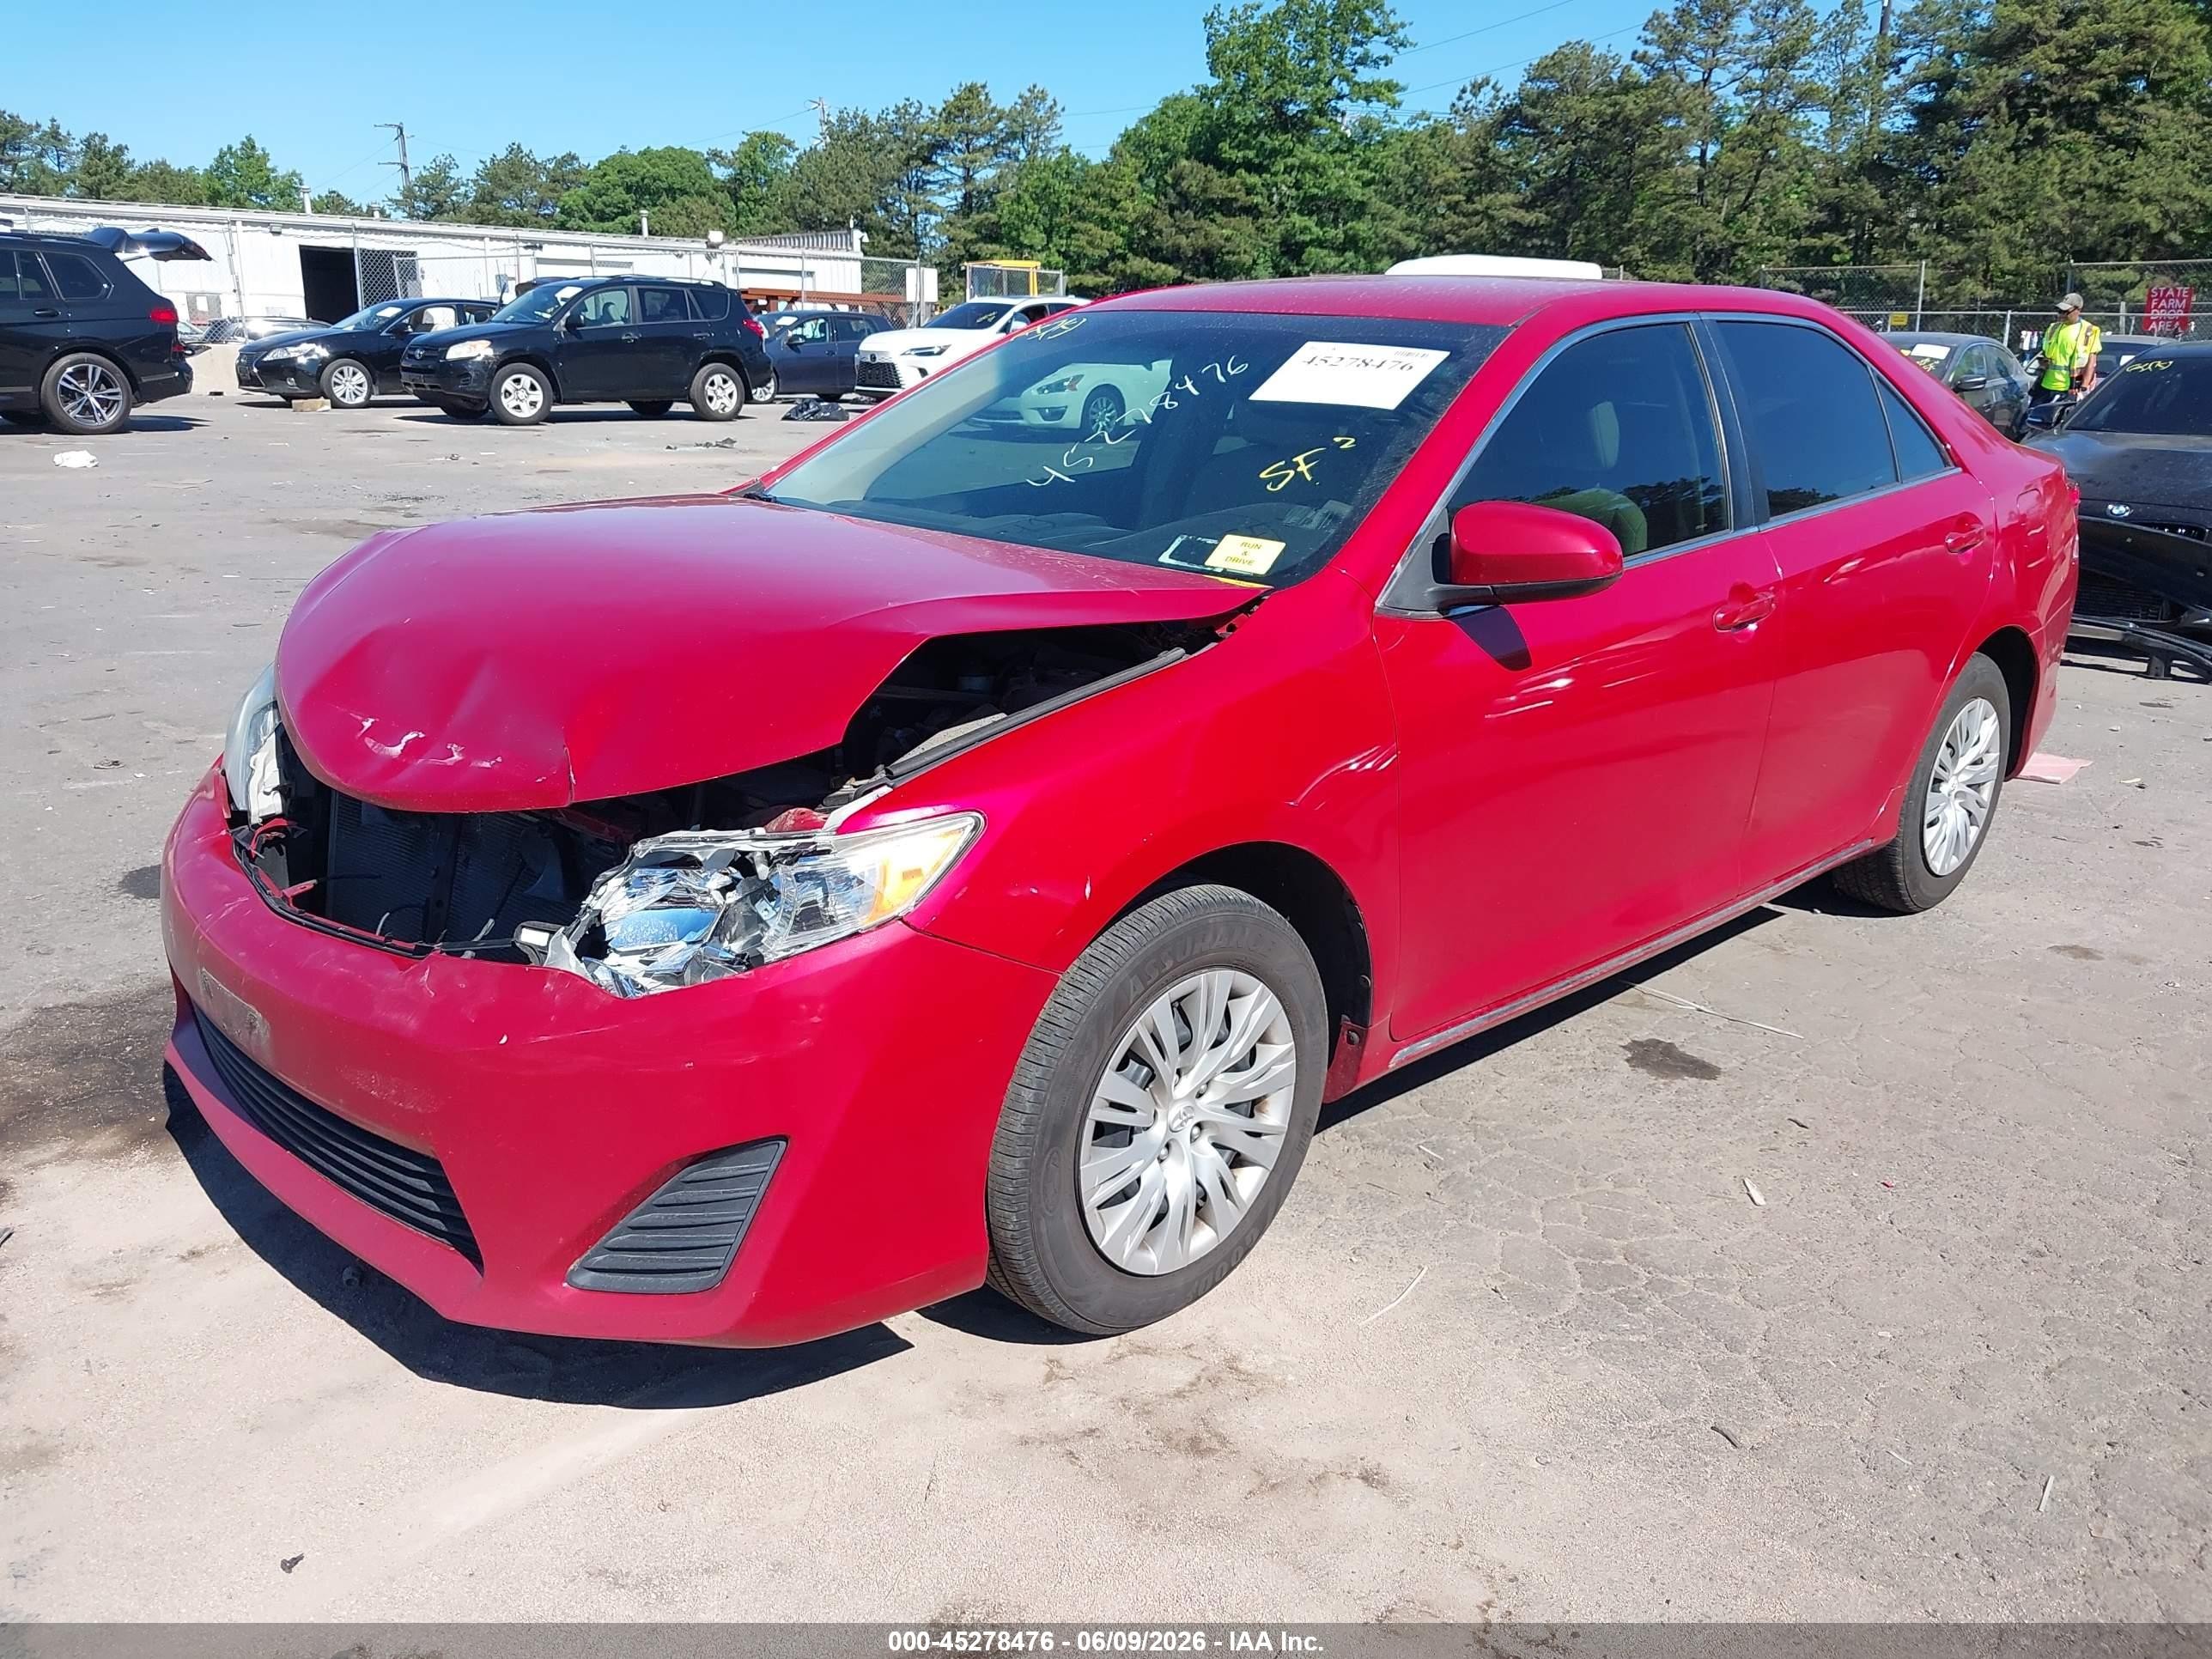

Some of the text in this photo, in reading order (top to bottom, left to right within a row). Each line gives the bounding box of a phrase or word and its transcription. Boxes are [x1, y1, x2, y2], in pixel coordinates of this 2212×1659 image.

[2150, 287, 2190, 298] STATE
[2150, 298, 2187, 309] FARM
[2149, 308, 2185, 320] DROP
[1302, 355, 1414, 372] 45278476
[1240, 541, 1262, 550] RUN
[1224, 556, 1255, 566] DRIVE
